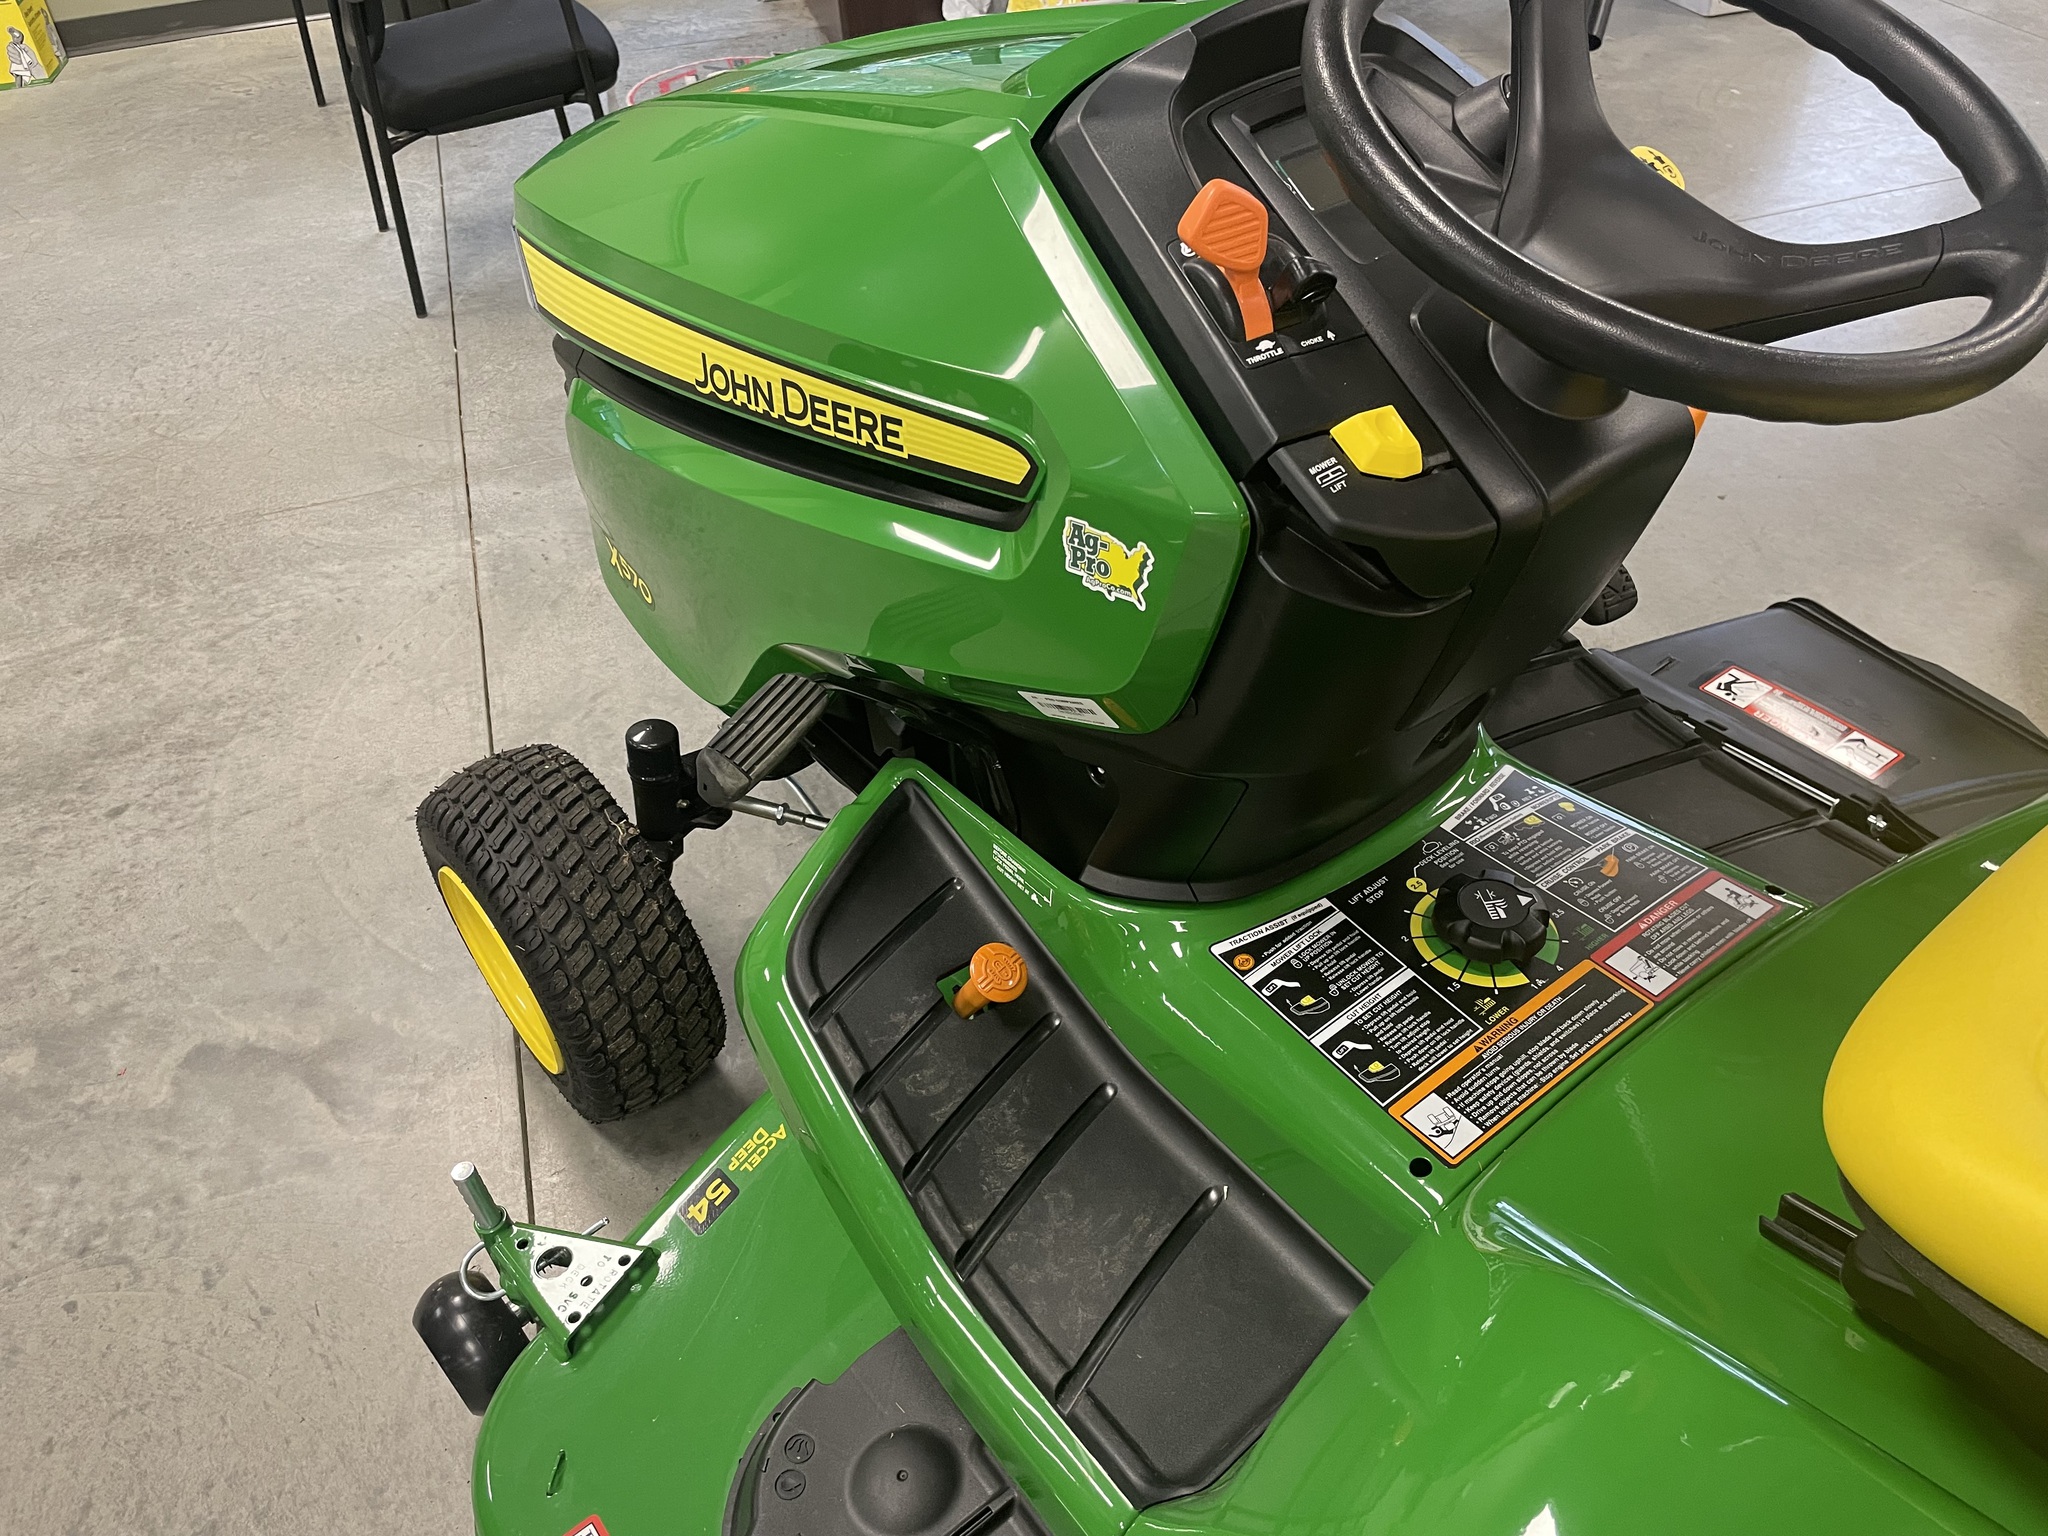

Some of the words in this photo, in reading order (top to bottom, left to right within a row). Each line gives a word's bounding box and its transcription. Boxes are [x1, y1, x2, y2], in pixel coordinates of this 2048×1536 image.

[1246, 347, 1284, 365] THROTTLE
[1300, 336, 1324, 347] CHOKE
[694, 352, 775, 413] JOHN
[781, 377, 905, 453] DEERE
[1308, 456, 1338, 476] MOWER
[1329, 480, 1347, 493] LIFT
[1068, 523, 1108, 556] Ag-
[605, 536, 653, 604] X570
[1070, 545, 1110, 577] Pro
[1085, 576, 1132, 597] AgProCo.com
[1419, 855, 1435, 866] DECK
[1434, 840, 1460, 856] LEVELING
[1434, 848, 1459, 865] POSITION
[1538, 873, 1565, 887] CRUISE
[1559, 857, 1592, 873] CONTROL
[1595, 842, 1612, 852] PARK
[1611, 832, 1630, 843] BRAKE
[1348, 893, 1364, 906] LIFT
[1363, 876, 1389, 896] ADJUST
[1366, 889, 1385, 905] STOP
[1411, 879, 1423, 890] 2.5
[1552, 909, 1565, 919] 3.5
[1644, 901, 1678, 924] DANGER
[1229, 929, 1264, 946] TRACTION
[1265, 919, 1288, 932] ASSIST
[1401, 935, 1409, 943] 2
[1585, 933, 1608, 951] HIGHER
[1271, 950, 1293, 967] MOWER
[1292, 941, 1305, 951] LIFT
[1305, 929, 1322, 942] LOCK
[1336, 970, 1358, 986] UNLOCK
[1357, 957, 1377, 971] MOWER
[1341, 981, 1352, 990] SET
[1351, 973, 1362, 982] CUT
[1361, 961, 1380, 975] HEIGHT
[1555, 965, 1564, 973] 4
[1447, 982, 1461, 994] 1.5
[1346, 1009, 1359, 1020] CUT
[1359, 993, 1381, 1011] HEIGHT
[1362, 1011, 1373, 1020] SET
[1372, 1003, 1384, 1013] CUT
[1383, 990, 1402, 1005] HEIGHT
[1485, 1006, 1510, 1026] LOWER
[1479, 1017, 1518, 1046] WARNING
[1482, 1045, 1498, 1059] AVOID
[1497, 1028, 1520, 1047] SERIOUS
[1518, 1015, 1537, 1030] INJURY
[1544, 997, 1562, 1010] DEATH
[1464, 1087, 1486, 1104] machine
[1485, 1076, 1500, 1088] stops
[1499, 1065, 1514, 1078] going
[1513, 1054, 1528, 1066] uphill,
[1527, 1045, 1539, 1054] stop
[1537, 1035, 1552, 1046] blade
[1551, 1027, 1561, 1036] and
[1559, 1020, 1572, 1029] back
[1571, 1010, 1584, 1021] down
[1584, 1000, 1599, 1011] slowly
[1465, 1101, 1480, 1112] Keep
[1479, 1089, 1495, 1102] safety
[1494, 1075, 1513, 1090] devices
[1550, 1038, 1560, 1047] and
[1585, 1009, 1598, 1020] place
[1598, 1001, 1608, 1010] and
[1607, 988, 1626, 1002] working
[1552, 1060, 1569, 1073] engine
[1578, 1044, 1590, 1054] park
[1588, 1034, 1603, 1044] brake
[1447, 1086, 1462, 1098] Read
[1461, 1068, 1486, 1087] operator's
[1485, 1054, 1503, 1069] manual
[1454, 1090, 1469, 1103] Avoid
[1468, 1076, 1487, 1091] sudden
[1485, 1066, 1500, 1077] turns
[1471, 1106, 1487, 1117] Drive
[1493, 1091, 1503, 1101] and
[1503, 1082, 1517, 1093] down
[1533, 1061, 1543, 1069] not
[1542, 1049, 1558, 1062] across
[1478, 1105, 1499, 1122] Remove
[1499, 1091, 1517, 1106] objects
[1516, 1083, 1527, 1092] that
[1526, 1076, 1537, 1084] can
[1541, 1058, 1559, 1072] thrown
[1564, 1043, 1579, 1054] blade
[728, 1127, 770, 1171] DEEP
[740, 1124, 787, 1172] ACCEL
[687, 1178, 732, 1224] 54
[560, 1263, 585, 1289] DECK
[597, 1255, 612, 1268] TO
[557, 1291, 578, 1312] SVC
[580, 1269, 618, 1309] ROTATE
